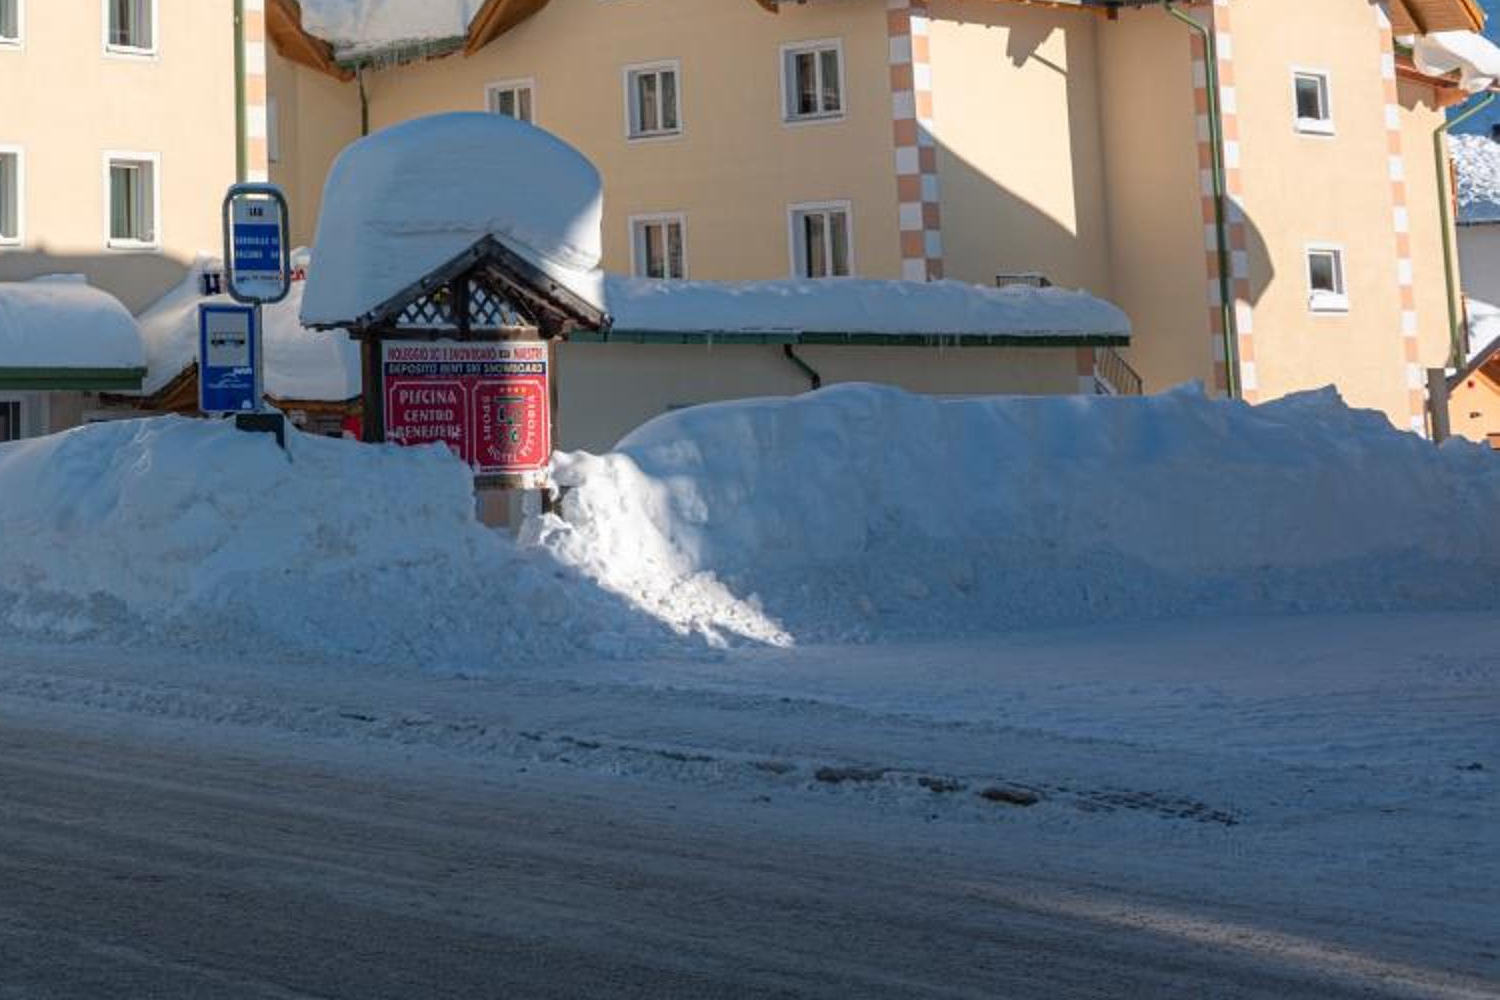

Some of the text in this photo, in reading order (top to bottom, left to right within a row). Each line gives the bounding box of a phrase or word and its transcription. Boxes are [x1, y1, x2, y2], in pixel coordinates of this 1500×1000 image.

[389, 363, 437, 374] DEPOSITO
[400, 390, 457, 405] PISCINA
[404, 409, 453, 422] CENTRO
